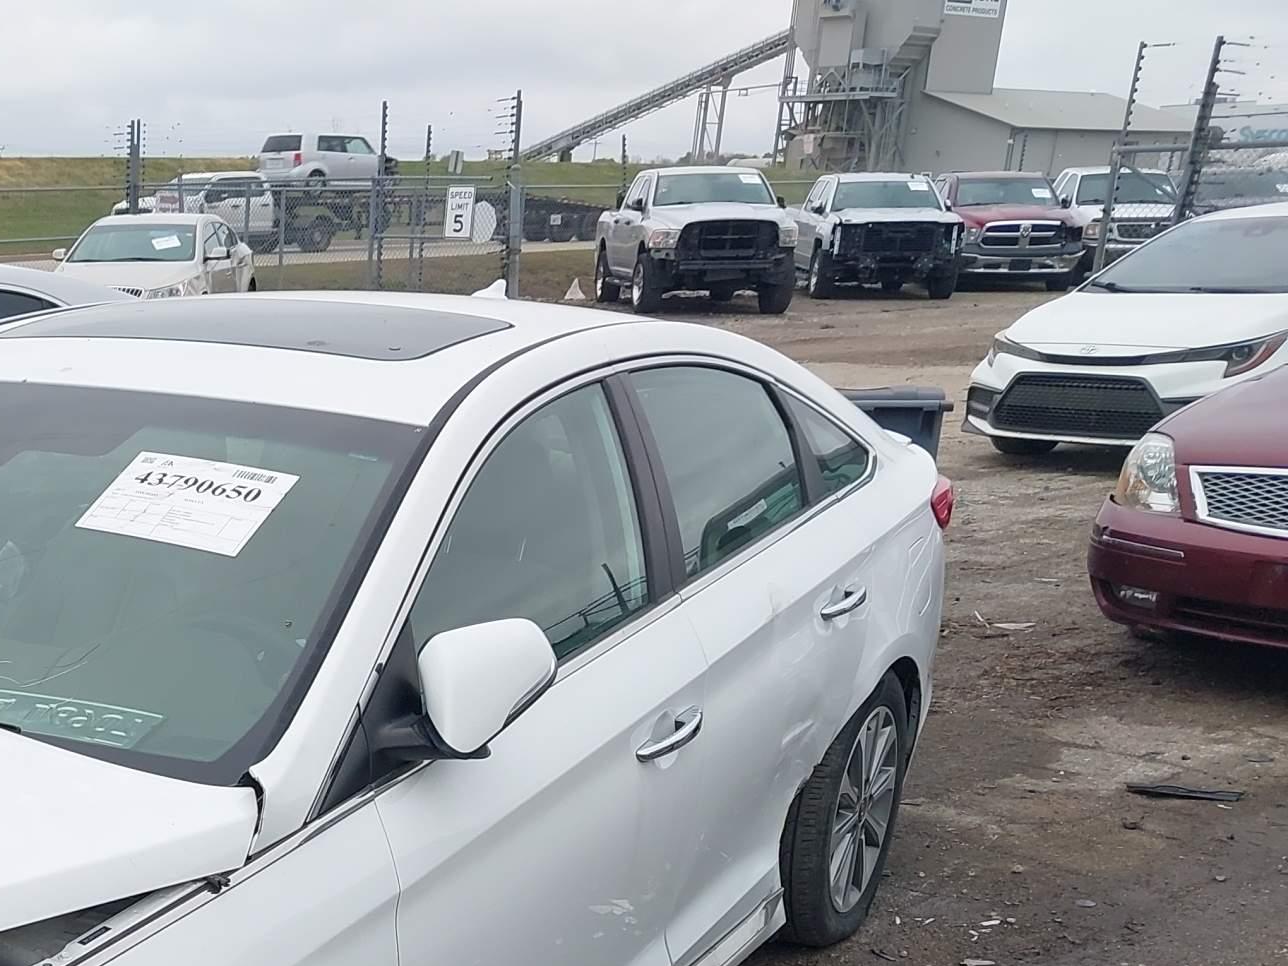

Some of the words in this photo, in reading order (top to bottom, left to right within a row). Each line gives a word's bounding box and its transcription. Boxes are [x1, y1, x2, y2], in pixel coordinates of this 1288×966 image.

[450, 191, 473, 200] SPEED
[450, 202, 470, 211] LIMIT
[452, 213, 464, 233] 5
[134, 469, 263, 503] 43790650
